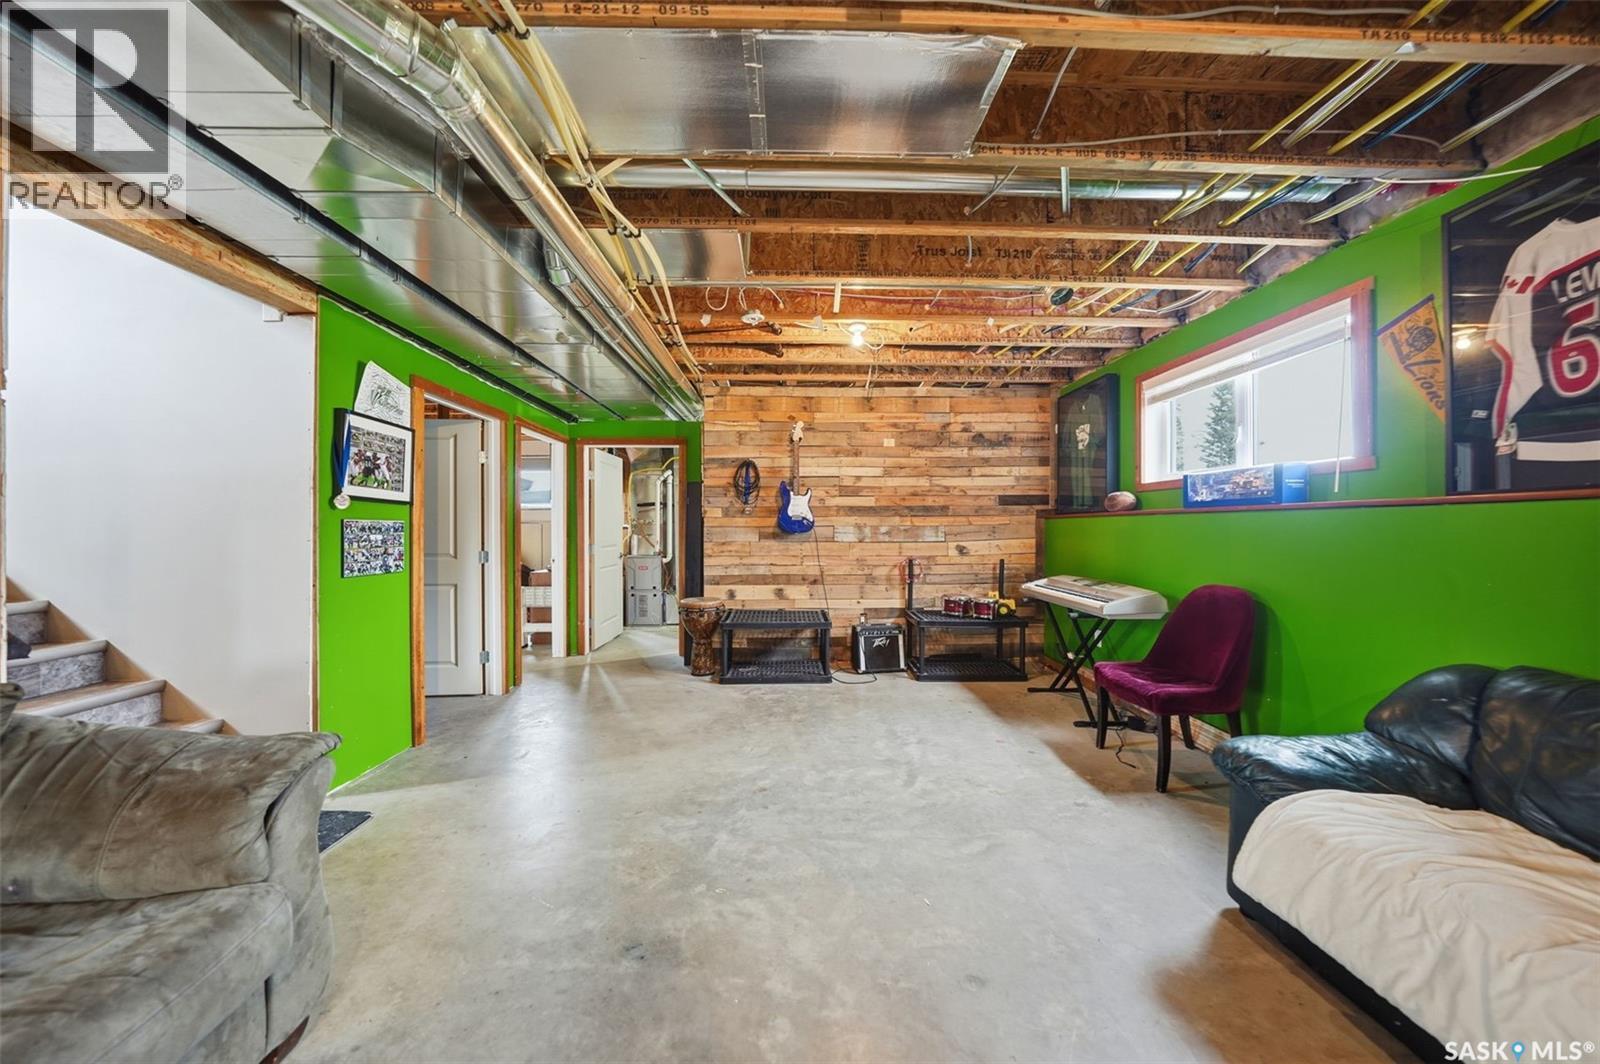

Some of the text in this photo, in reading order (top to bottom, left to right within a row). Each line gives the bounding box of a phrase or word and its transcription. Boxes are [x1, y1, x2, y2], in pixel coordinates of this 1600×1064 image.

[563, 4, 640, 15] 12-21-12
[658, 5, 710, 16] 09:55
[916, 245, 946, 257] Trus
